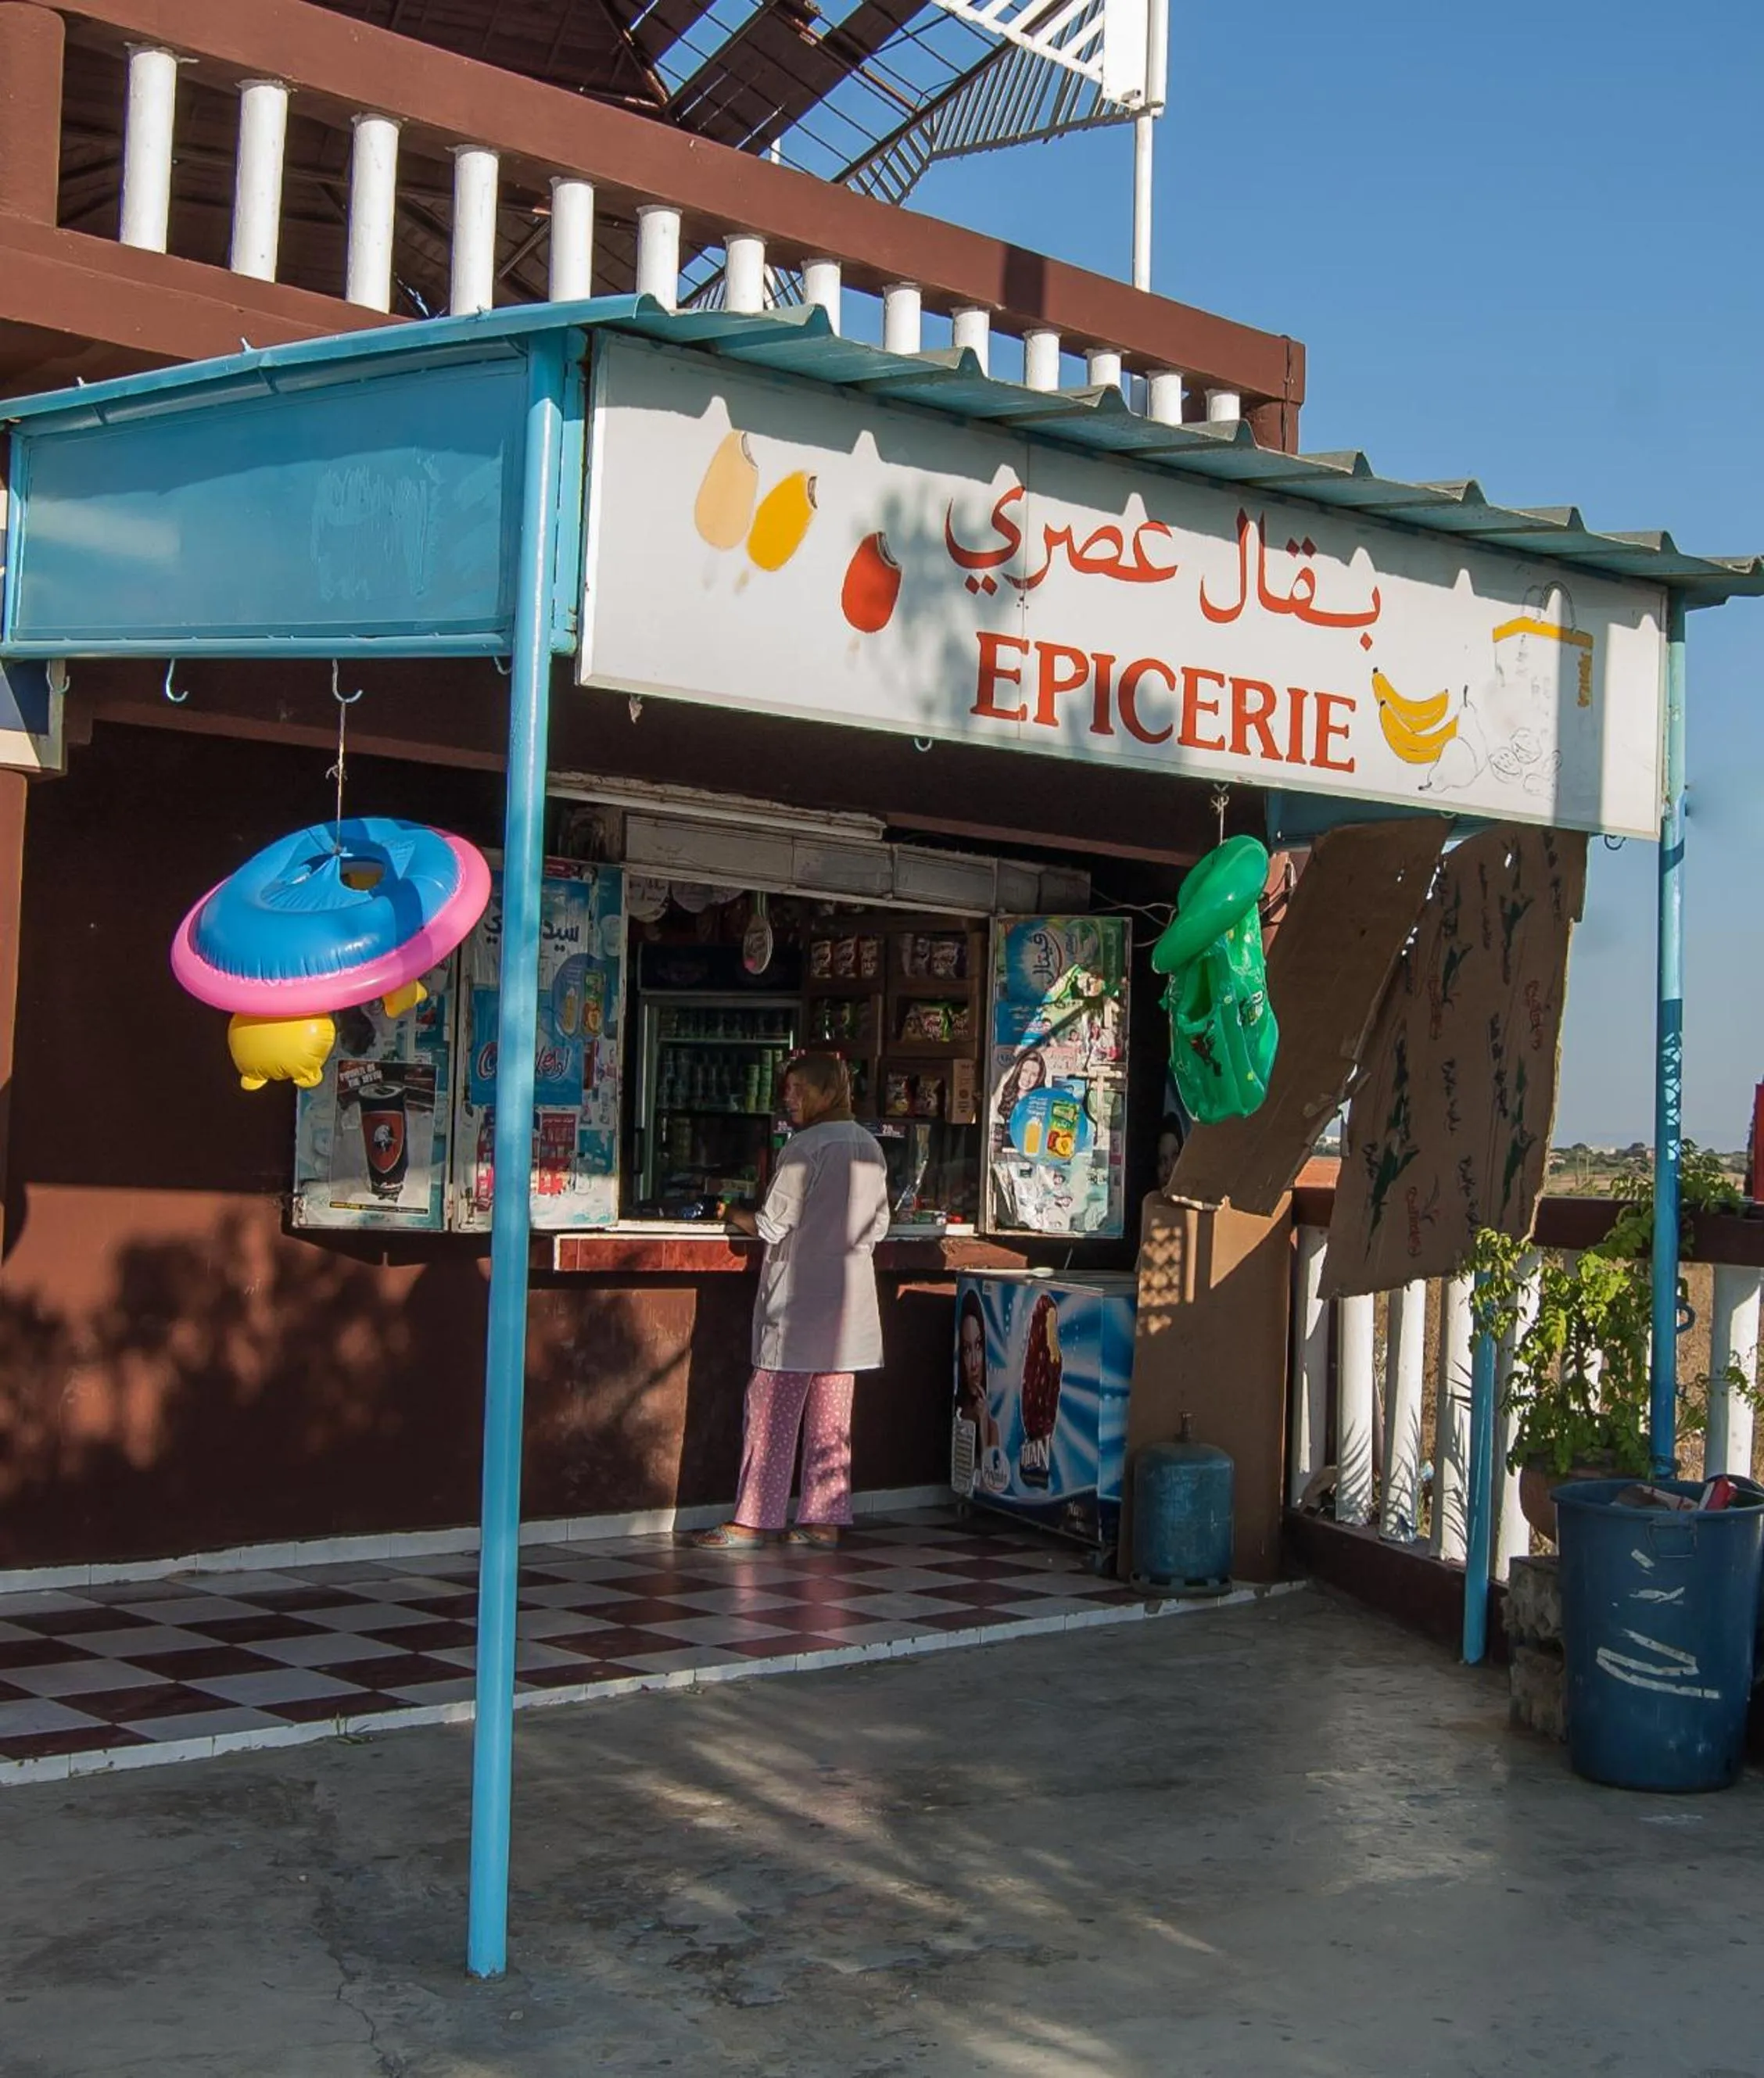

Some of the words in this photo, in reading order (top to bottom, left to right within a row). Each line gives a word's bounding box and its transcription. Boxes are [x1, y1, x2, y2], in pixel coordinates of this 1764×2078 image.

[945, 485, 1178, 596] عصري
[1200, 507, 1381, 651] بقال
[970, 631, 1357, 773] EPICERIE
